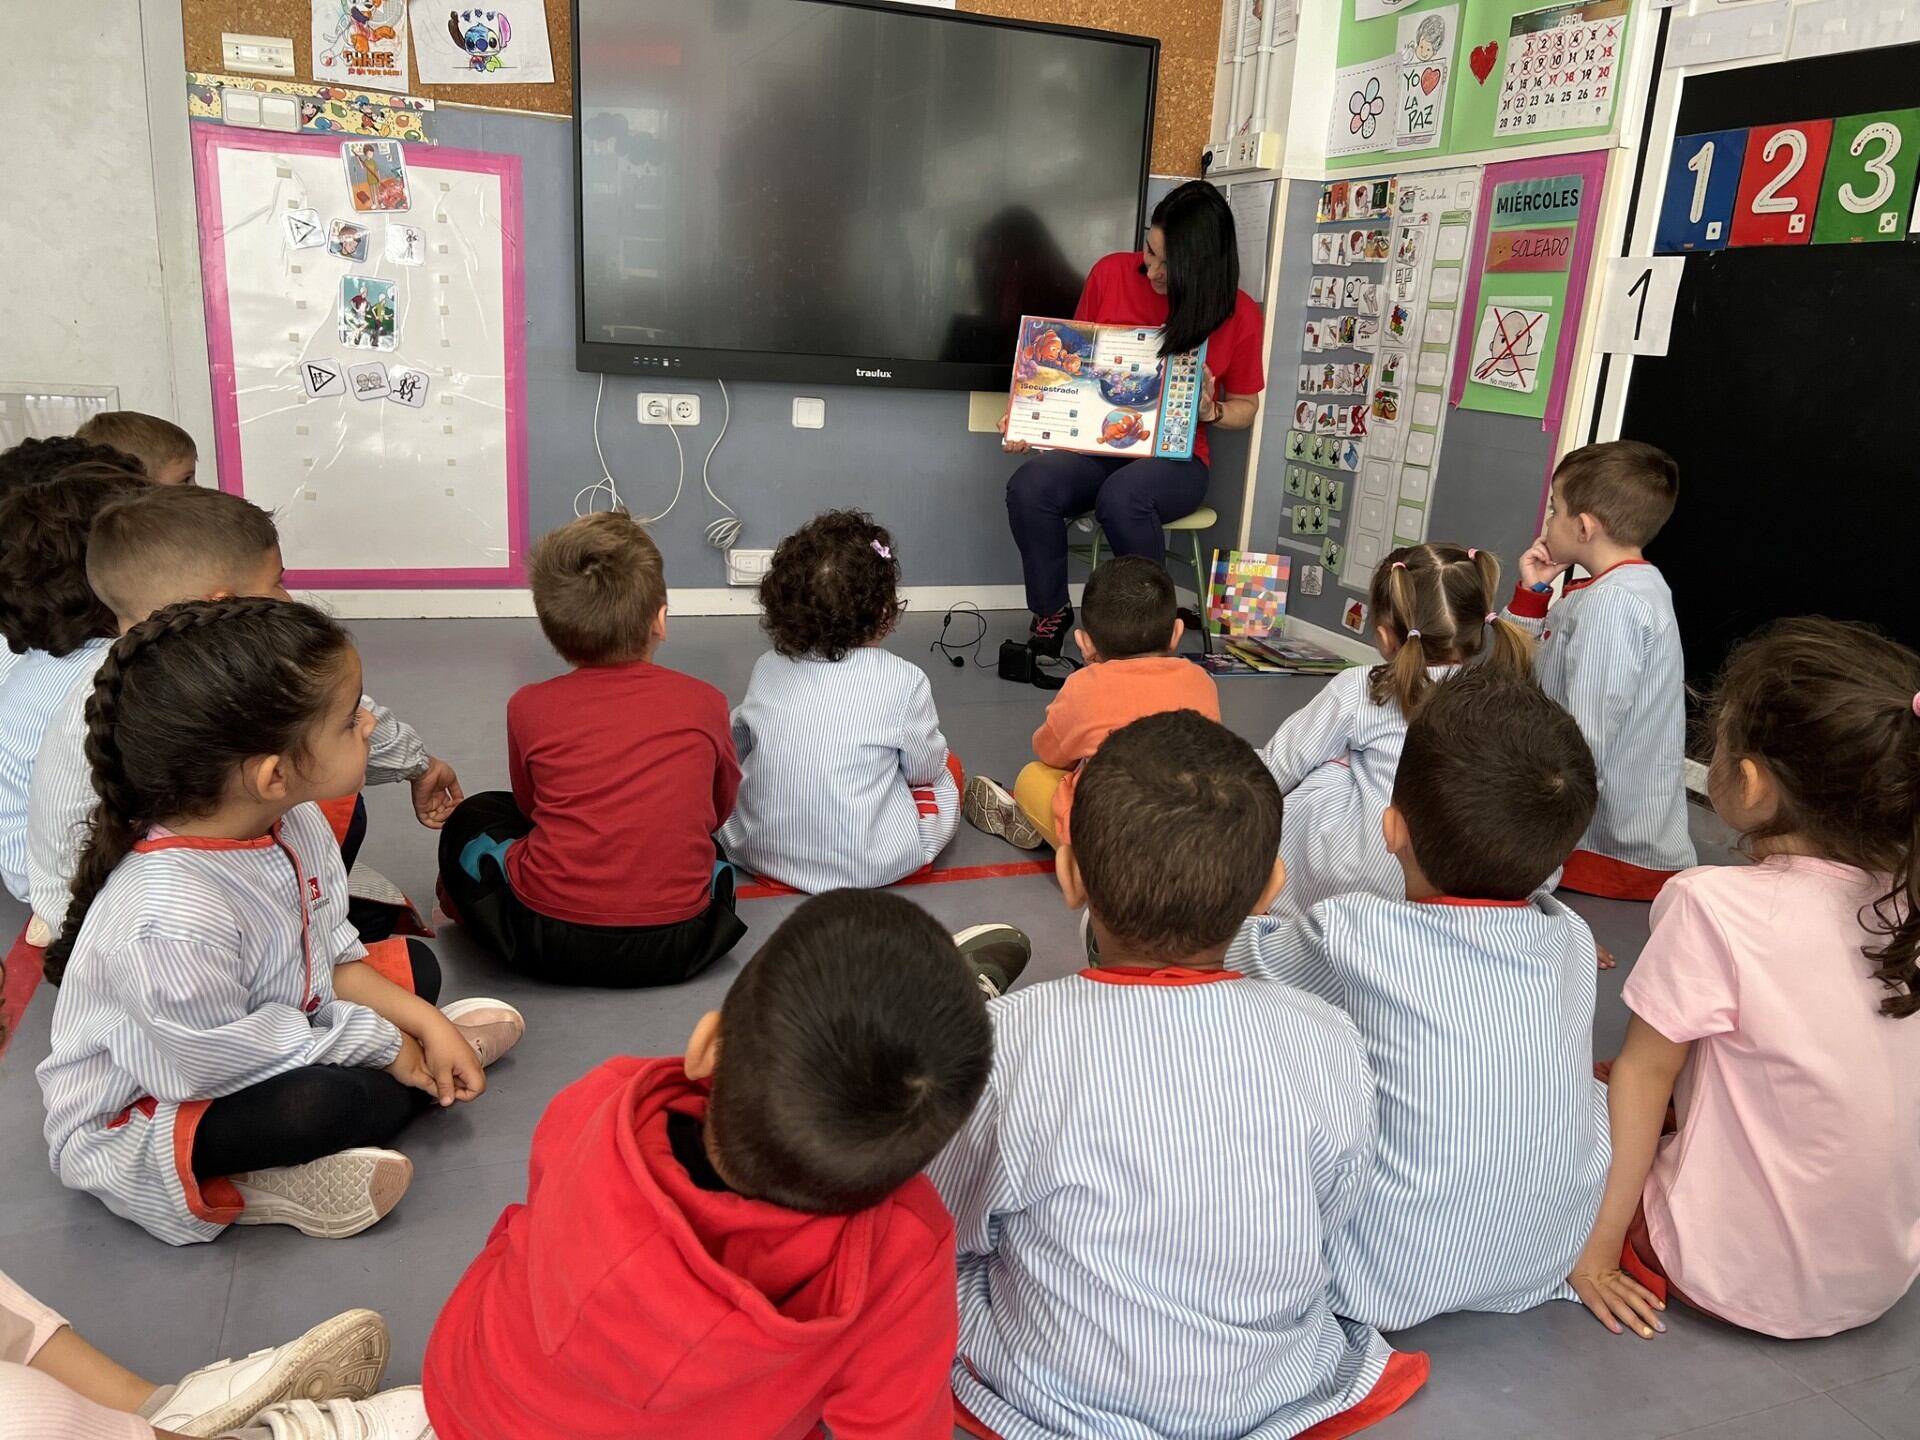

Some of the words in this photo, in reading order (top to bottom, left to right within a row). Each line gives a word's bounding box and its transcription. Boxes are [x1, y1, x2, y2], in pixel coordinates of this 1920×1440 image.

[1558, 13, 1584, 27] ABRIL
[1541, 38, 1547, 49] 2
[1591, 30, 1597, 40] 5
[1523, 61, 1529, 71] 8
[1538, 58, 1544, 68] 9
[1552, 55, 1561, 65] 10
[1585, 49, 1595, 60] 12
[1404, 69, 1420, 91] YO
[1505, 81, 1513, 92] 14
[1549, 75, 1557, 85] 17
[1565, 72, 1575, 82] 18
[1582, 69, 1591, 79] 19
[1598, 66, 1610, 78] 20
[1404, 96, 1418, 110] LA
[1516, 97, 1525, 108] 22
[1530, 95, 1539, 106] 23
[1545, 93, 1554, 104] 24
[1561, 91, 1571, 102] 25
[1578, 89, 1588, 100] 26
[1595, 87, 1607, 98] 27
[1408, 104, 1433, 133] PAZ
[1499, 118, 1508, 128] 28
[1513, 116, 1522, 126] 29
[1527, 114, 1536, 125] 30
[1687, 141, 1715, 224] 1
[1751, 129, 1808, 214] 2
[1838, 122, 1902, 214] 3
[1496, 188, 1579, 214] MIÉRCOLES
[1511, 237, 1569, 258] SOLEADO
[1628, 268, 1653, 340] 1
[856, 368, 892, 378] traulux
